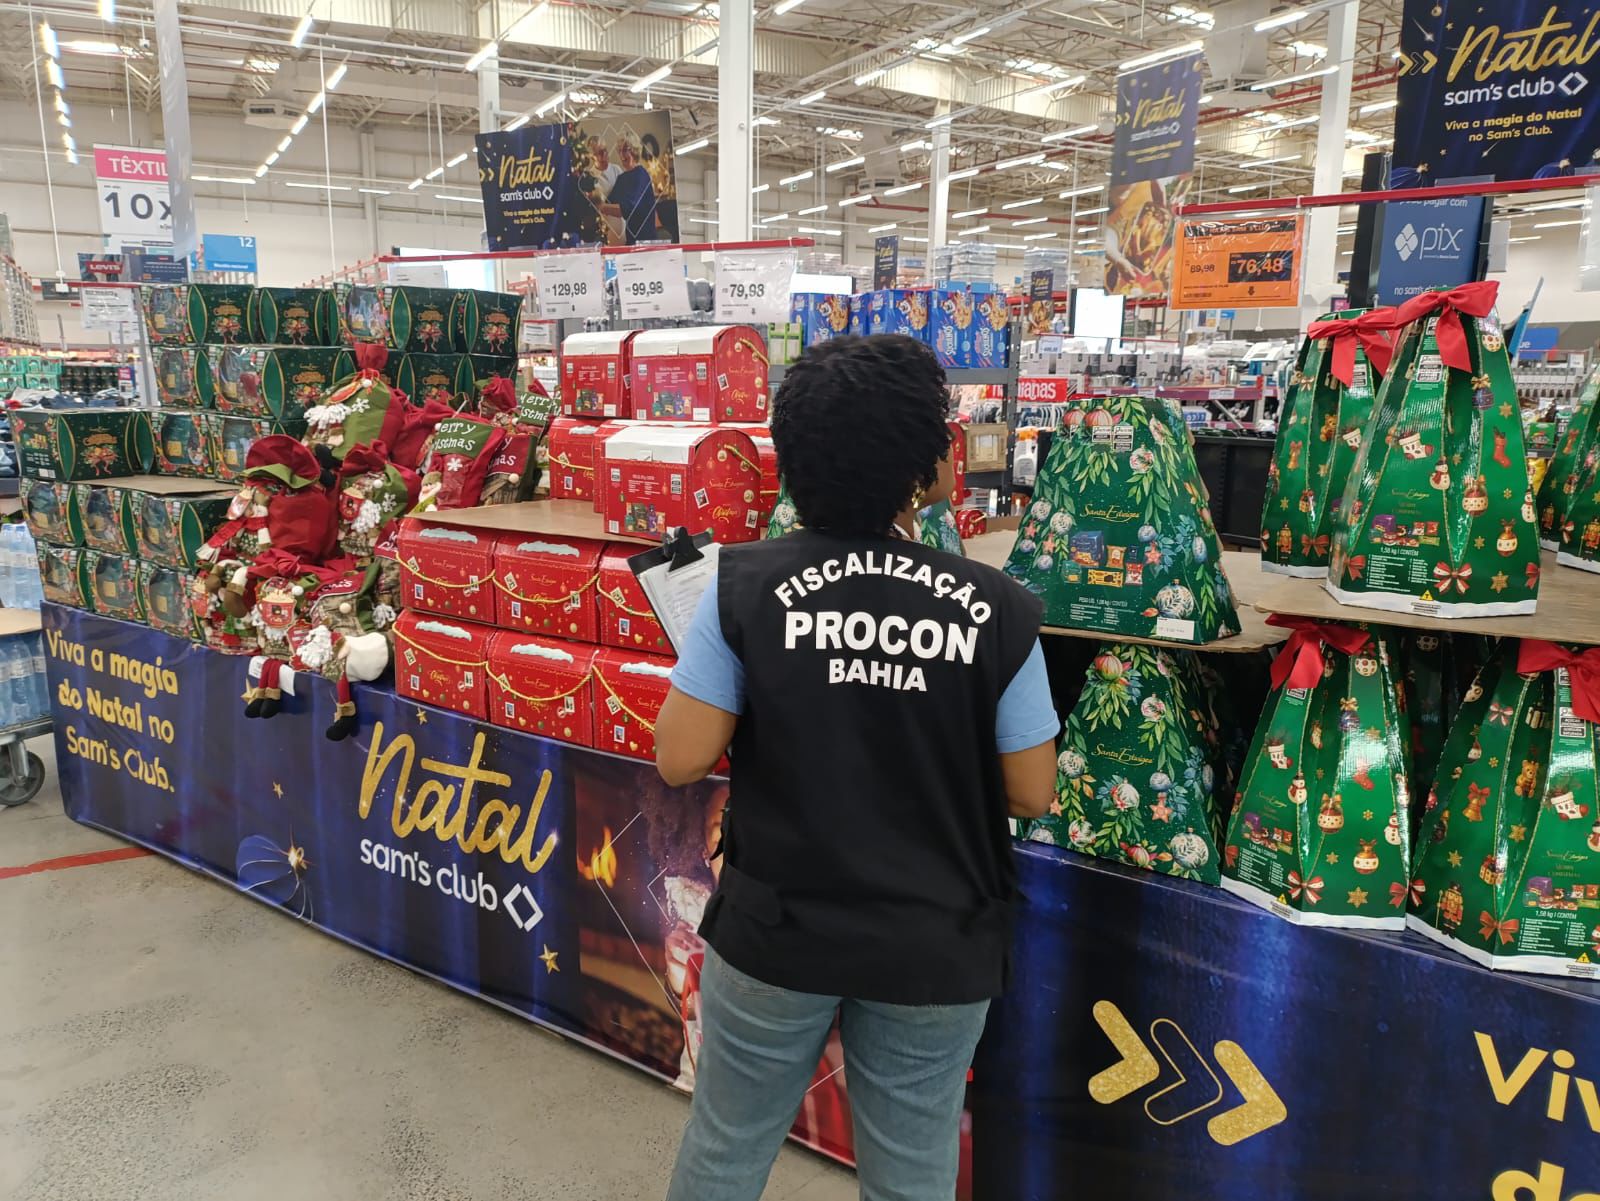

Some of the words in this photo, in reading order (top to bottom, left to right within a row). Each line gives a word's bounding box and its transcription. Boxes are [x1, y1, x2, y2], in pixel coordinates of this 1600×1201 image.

[1447, 6, 1600, 82] Natal
[1132, 87, 1186, 128] Natal
[1444, 83, 1503, 105] sam's
[1508, 77, 1555, 98] club
[1445, 121, 1470, 131] Viva
[1473, 120, 1481, 128] a
[1484, 113, 1522, 128] magia
[1527, 111, 1543, 122] do
[1547, 107, 1582, 120] Natal
[1469, 133, 1483, 142] no
[1487, 128, 1521, 141] Sam's
[1524, 125, 1553, 137] Club.
[499, 146, 555, 188] Natal
[500, 190, 523, 202] sam's
[523, 188, 542, 200] club
[239, 237, 254, 249] 12
[1419, 223, 1463, 260] pix
[1236, 258, 1283, 276] 76,48
[552, 282, 587, 297] 129,98
[632, 281, 664, 297] 99,98
[440, 422, 476, 435] erry
[774, 551, 992, 625] FISCALIZAÇÃO
[785, 611, 978, 664] PROCON
[46, 629, 85, 667] Viva
[91, 649, 104, 672] a
[110, 654, 179, 699] magia
[828, 658, 927, 692] BAHIA
[58, 678, 83, 711] do
[87, 689, 142, 733] Natal
[149, 715, 175, 744] no
[66, 725, 121, 770] Sam's
[124, 749, 175, 793] Club.
[358, 721, 558, 874] Natal
[360, 837, 431, 888] sam's
[437, 863, 498, 912] club
